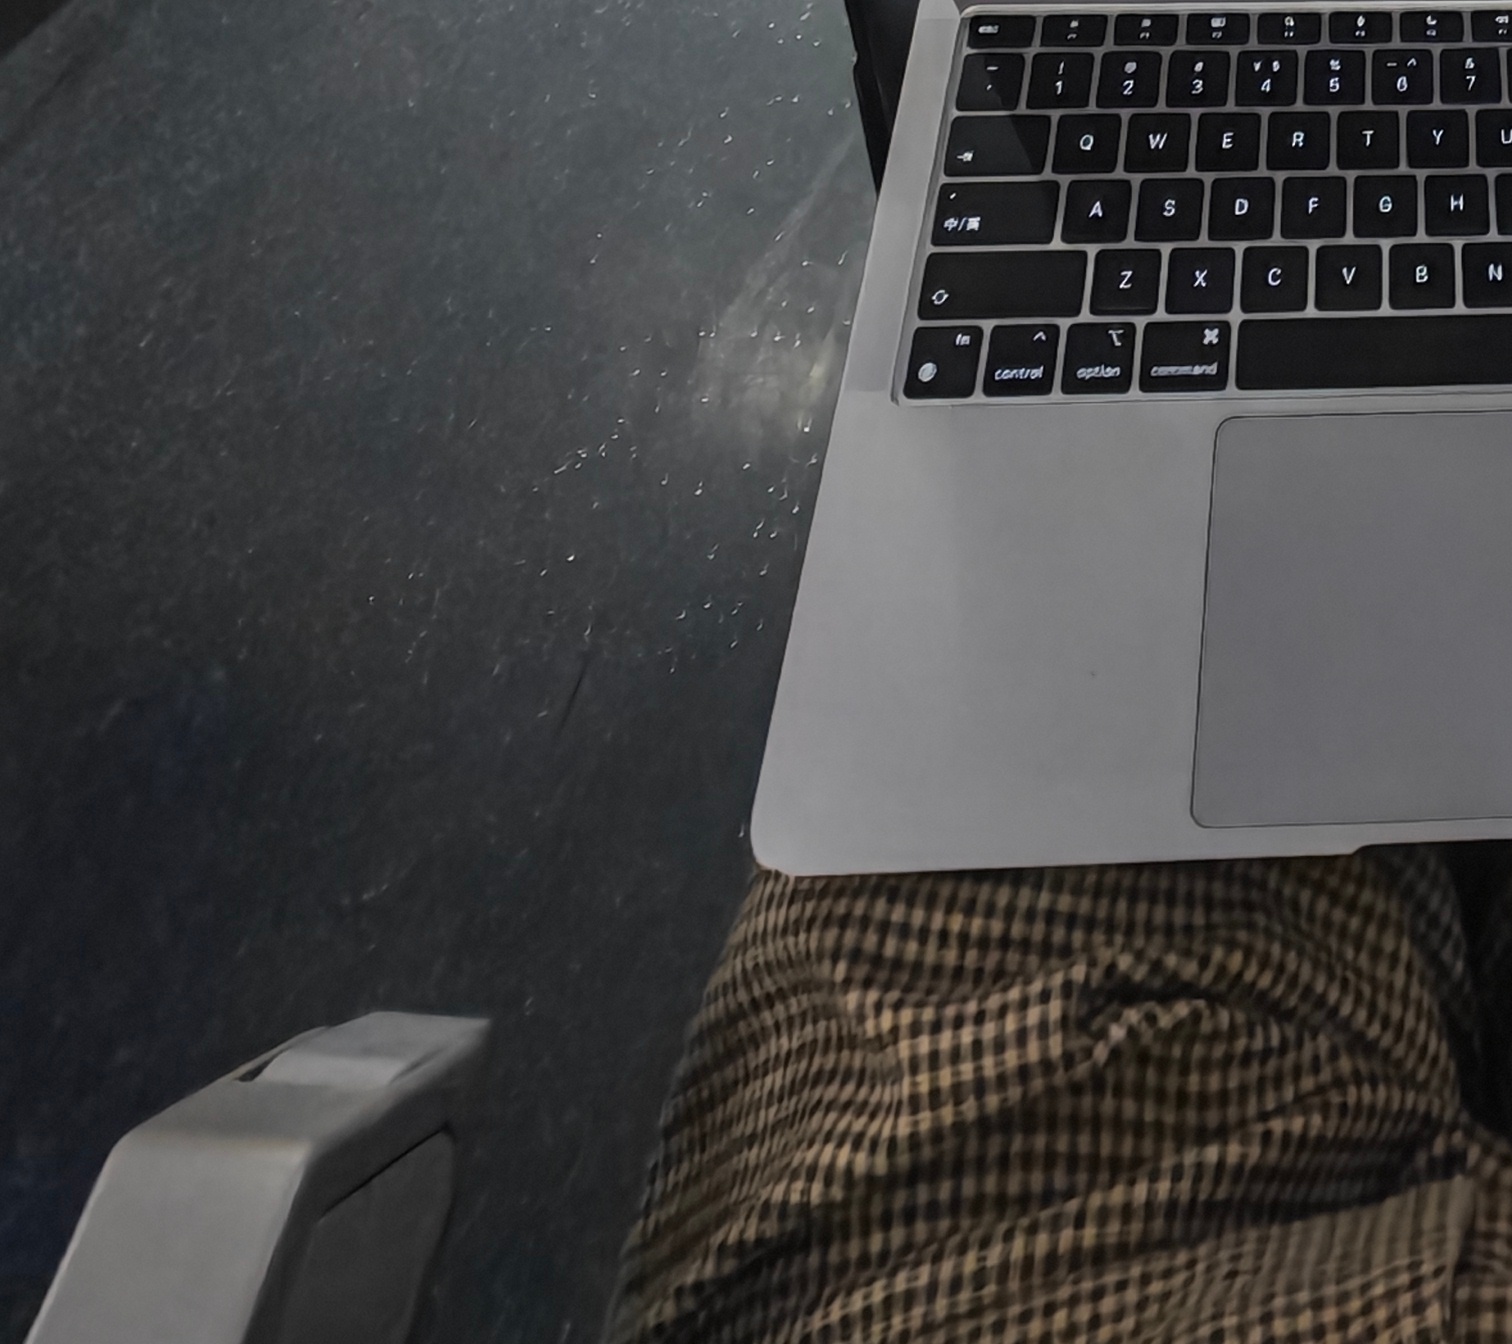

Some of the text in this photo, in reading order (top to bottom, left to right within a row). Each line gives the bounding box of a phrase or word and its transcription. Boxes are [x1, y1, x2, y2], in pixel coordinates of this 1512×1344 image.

[1055, 80, 1063, 95] 1
[1123, 79, 1134, 95] 2
[1191, 79, 1204, 94] 3
[1260, 78, 1271, 93] 4
[1329, 77, 1340, 93] 5
[1466, 75, 1476, 90] 7
[1079, 134, 1094, 151] Q
[1148, 133, 1168, 150] W
[1221, 132, 1234, 149] E
[1291, 131, 1305, 147] R
[1362, 130, 1374, 147] T
[1432, 129, 1444, 145] Y
[1088, 200, 1103, 218] A
[1162, 199, 1176, 217] S
[1234, 198, 1249, 216] D
[1308, 197, 1319, 214] F
[1378, 195, 1393, 213] G
[1450, 194, 1464, 211] H
[1119, 270, 1133, 289] Z
[1193, 269, 1208, 288] X
[1267, 267, 1282, 286] C
[1342, 266, 1356, 285] V
[1415, 265, 1429, 283] B
[1488, 263, 1503, 281] N
[994, 365, 1044, 381] control
